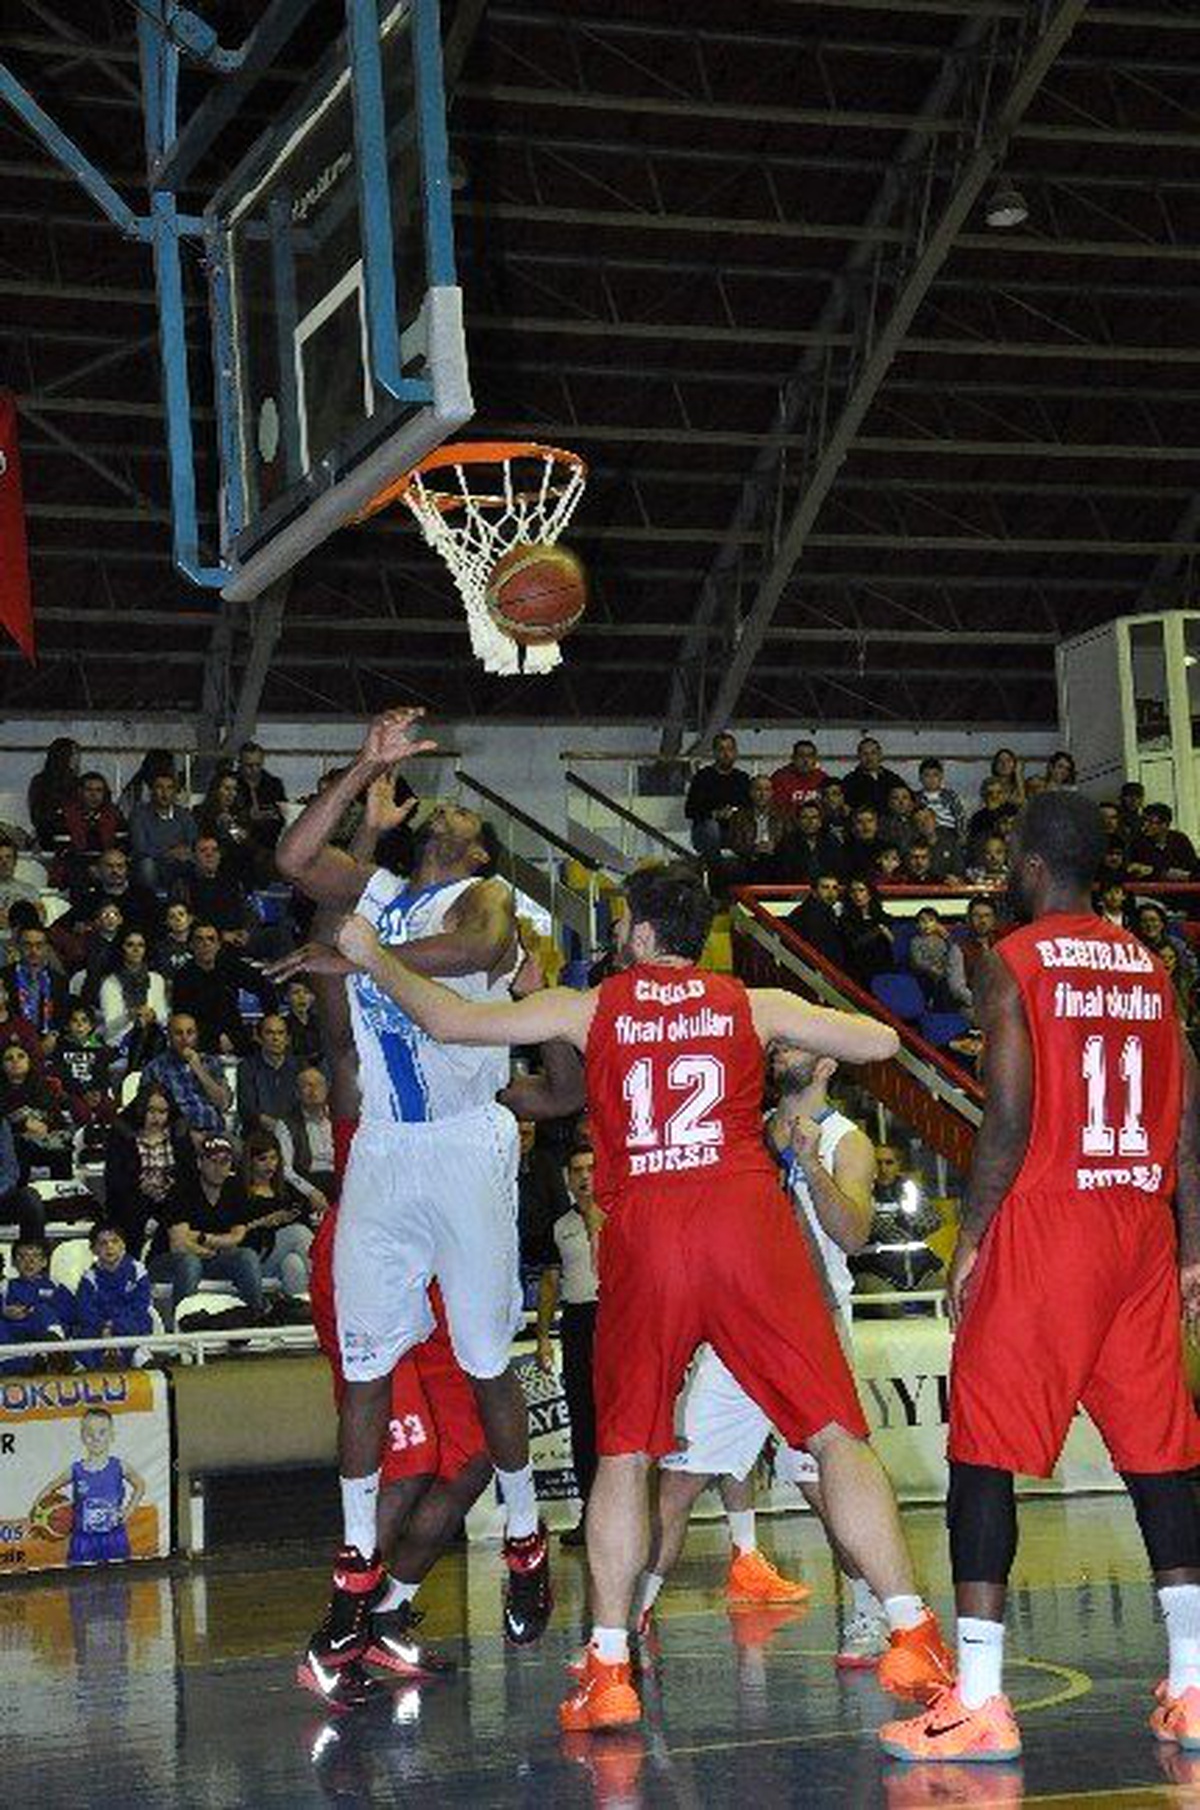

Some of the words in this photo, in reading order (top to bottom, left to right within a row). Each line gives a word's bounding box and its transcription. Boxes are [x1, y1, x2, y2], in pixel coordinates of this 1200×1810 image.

[1054, 982, 1104, 1018] final
[615, 1014, 664, 1045] final
[622, 1054, 725, 1148] 12
[1082, 1035, 1149, 1157] 11
[0, 1375, 127, 1411] OKULU
[2, 1433, 15, 1454] R
